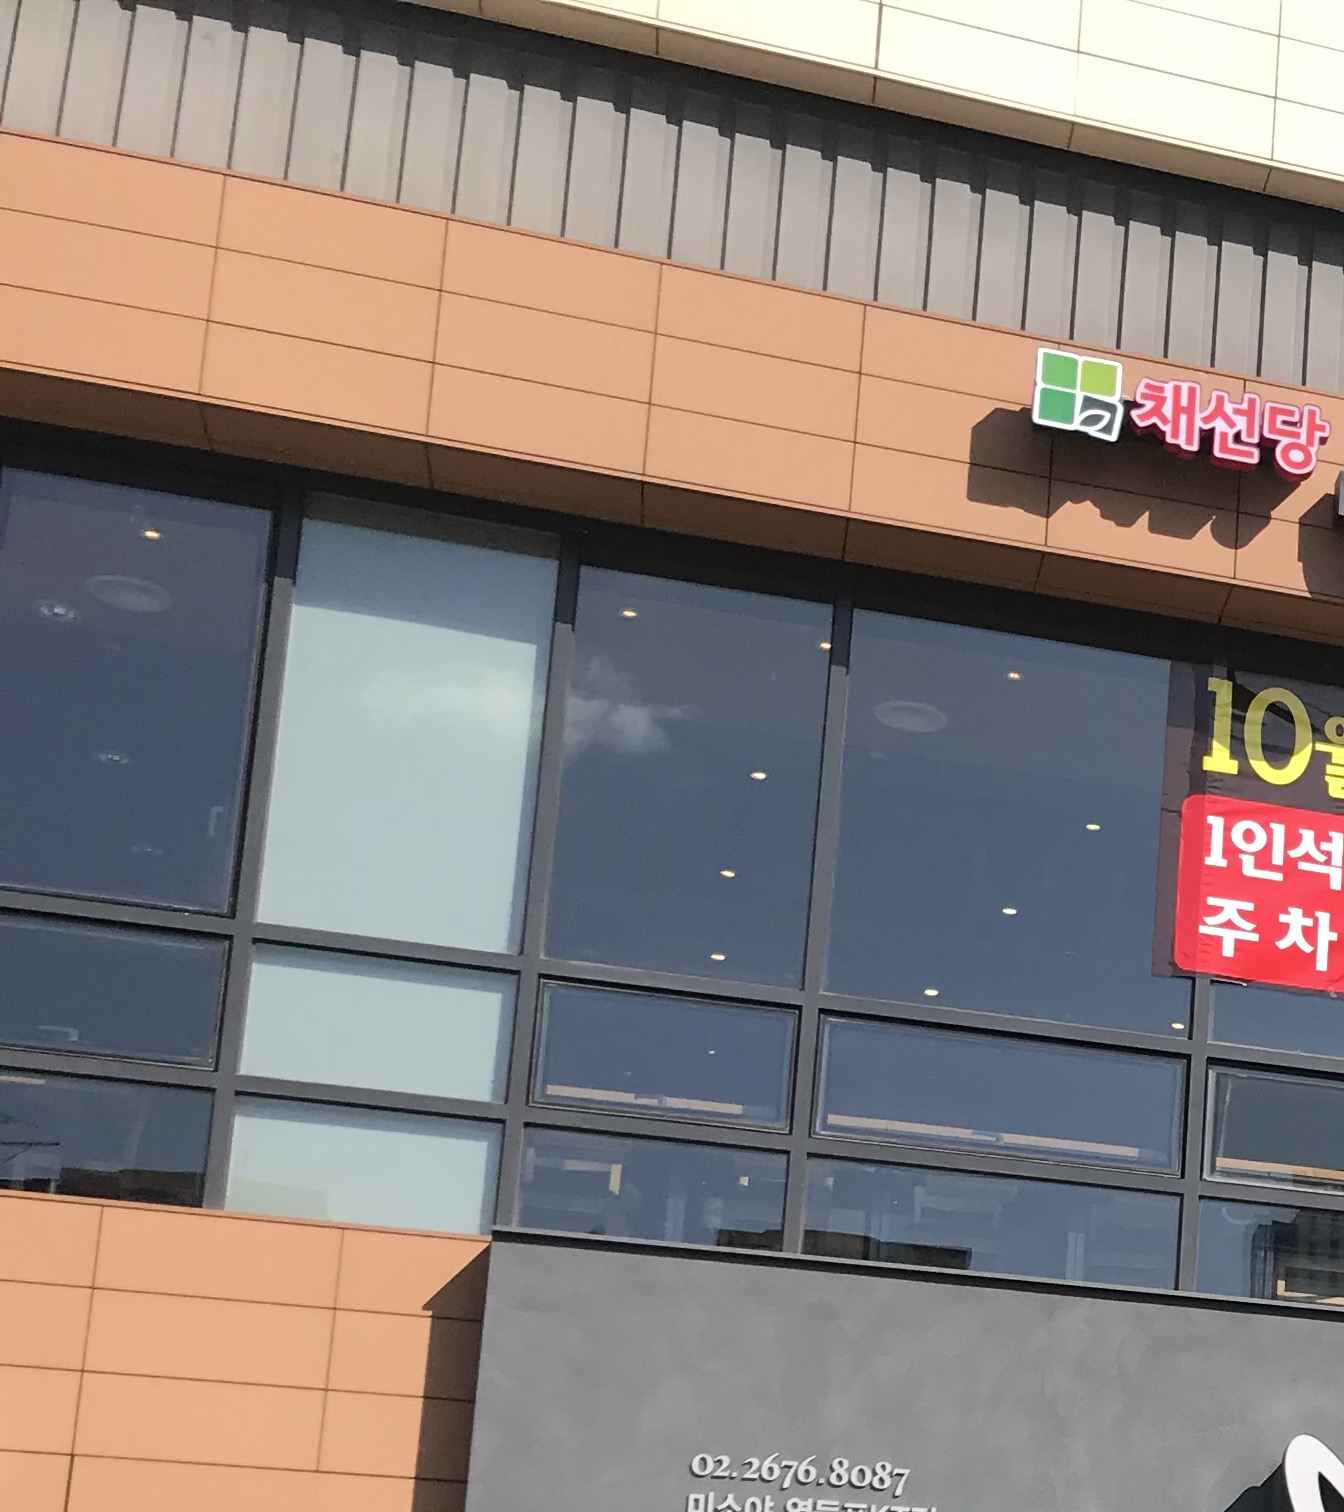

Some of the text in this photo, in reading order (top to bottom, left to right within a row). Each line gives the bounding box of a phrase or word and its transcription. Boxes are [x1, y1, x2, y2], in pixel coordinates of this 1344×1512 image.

[1132, 376, 1330, 477] 채선당
[1204, 815, 1344, 891] 1인석
[689, 1452, 911, 1498] 02.2676.8087
